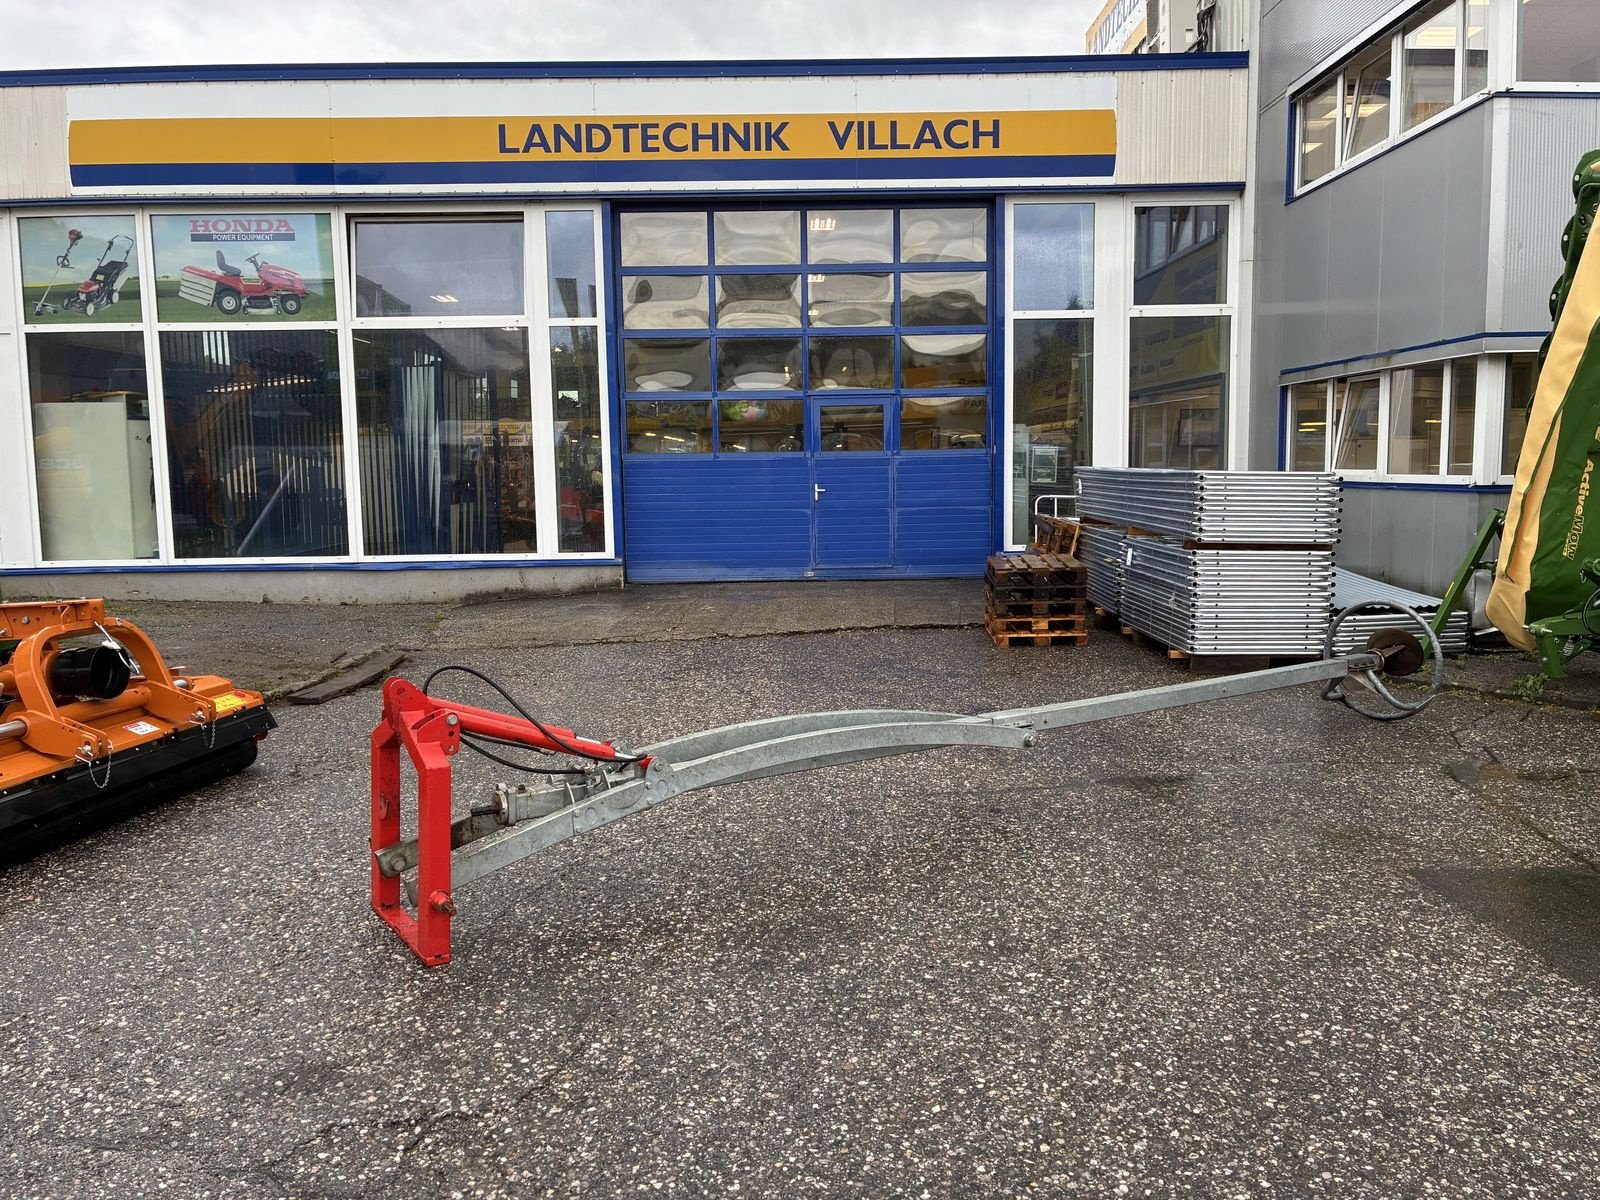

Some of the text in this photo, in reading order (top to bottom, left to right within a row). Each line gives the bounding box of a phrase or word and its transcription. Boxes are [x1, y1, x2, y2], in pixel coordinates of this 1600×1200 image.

[498, 118, 1000, 153] LANDTECHNIK VILLACH
[190, 219, 295, 232] HONDA
[1566, 458, 1595, 561] ActiveMow
